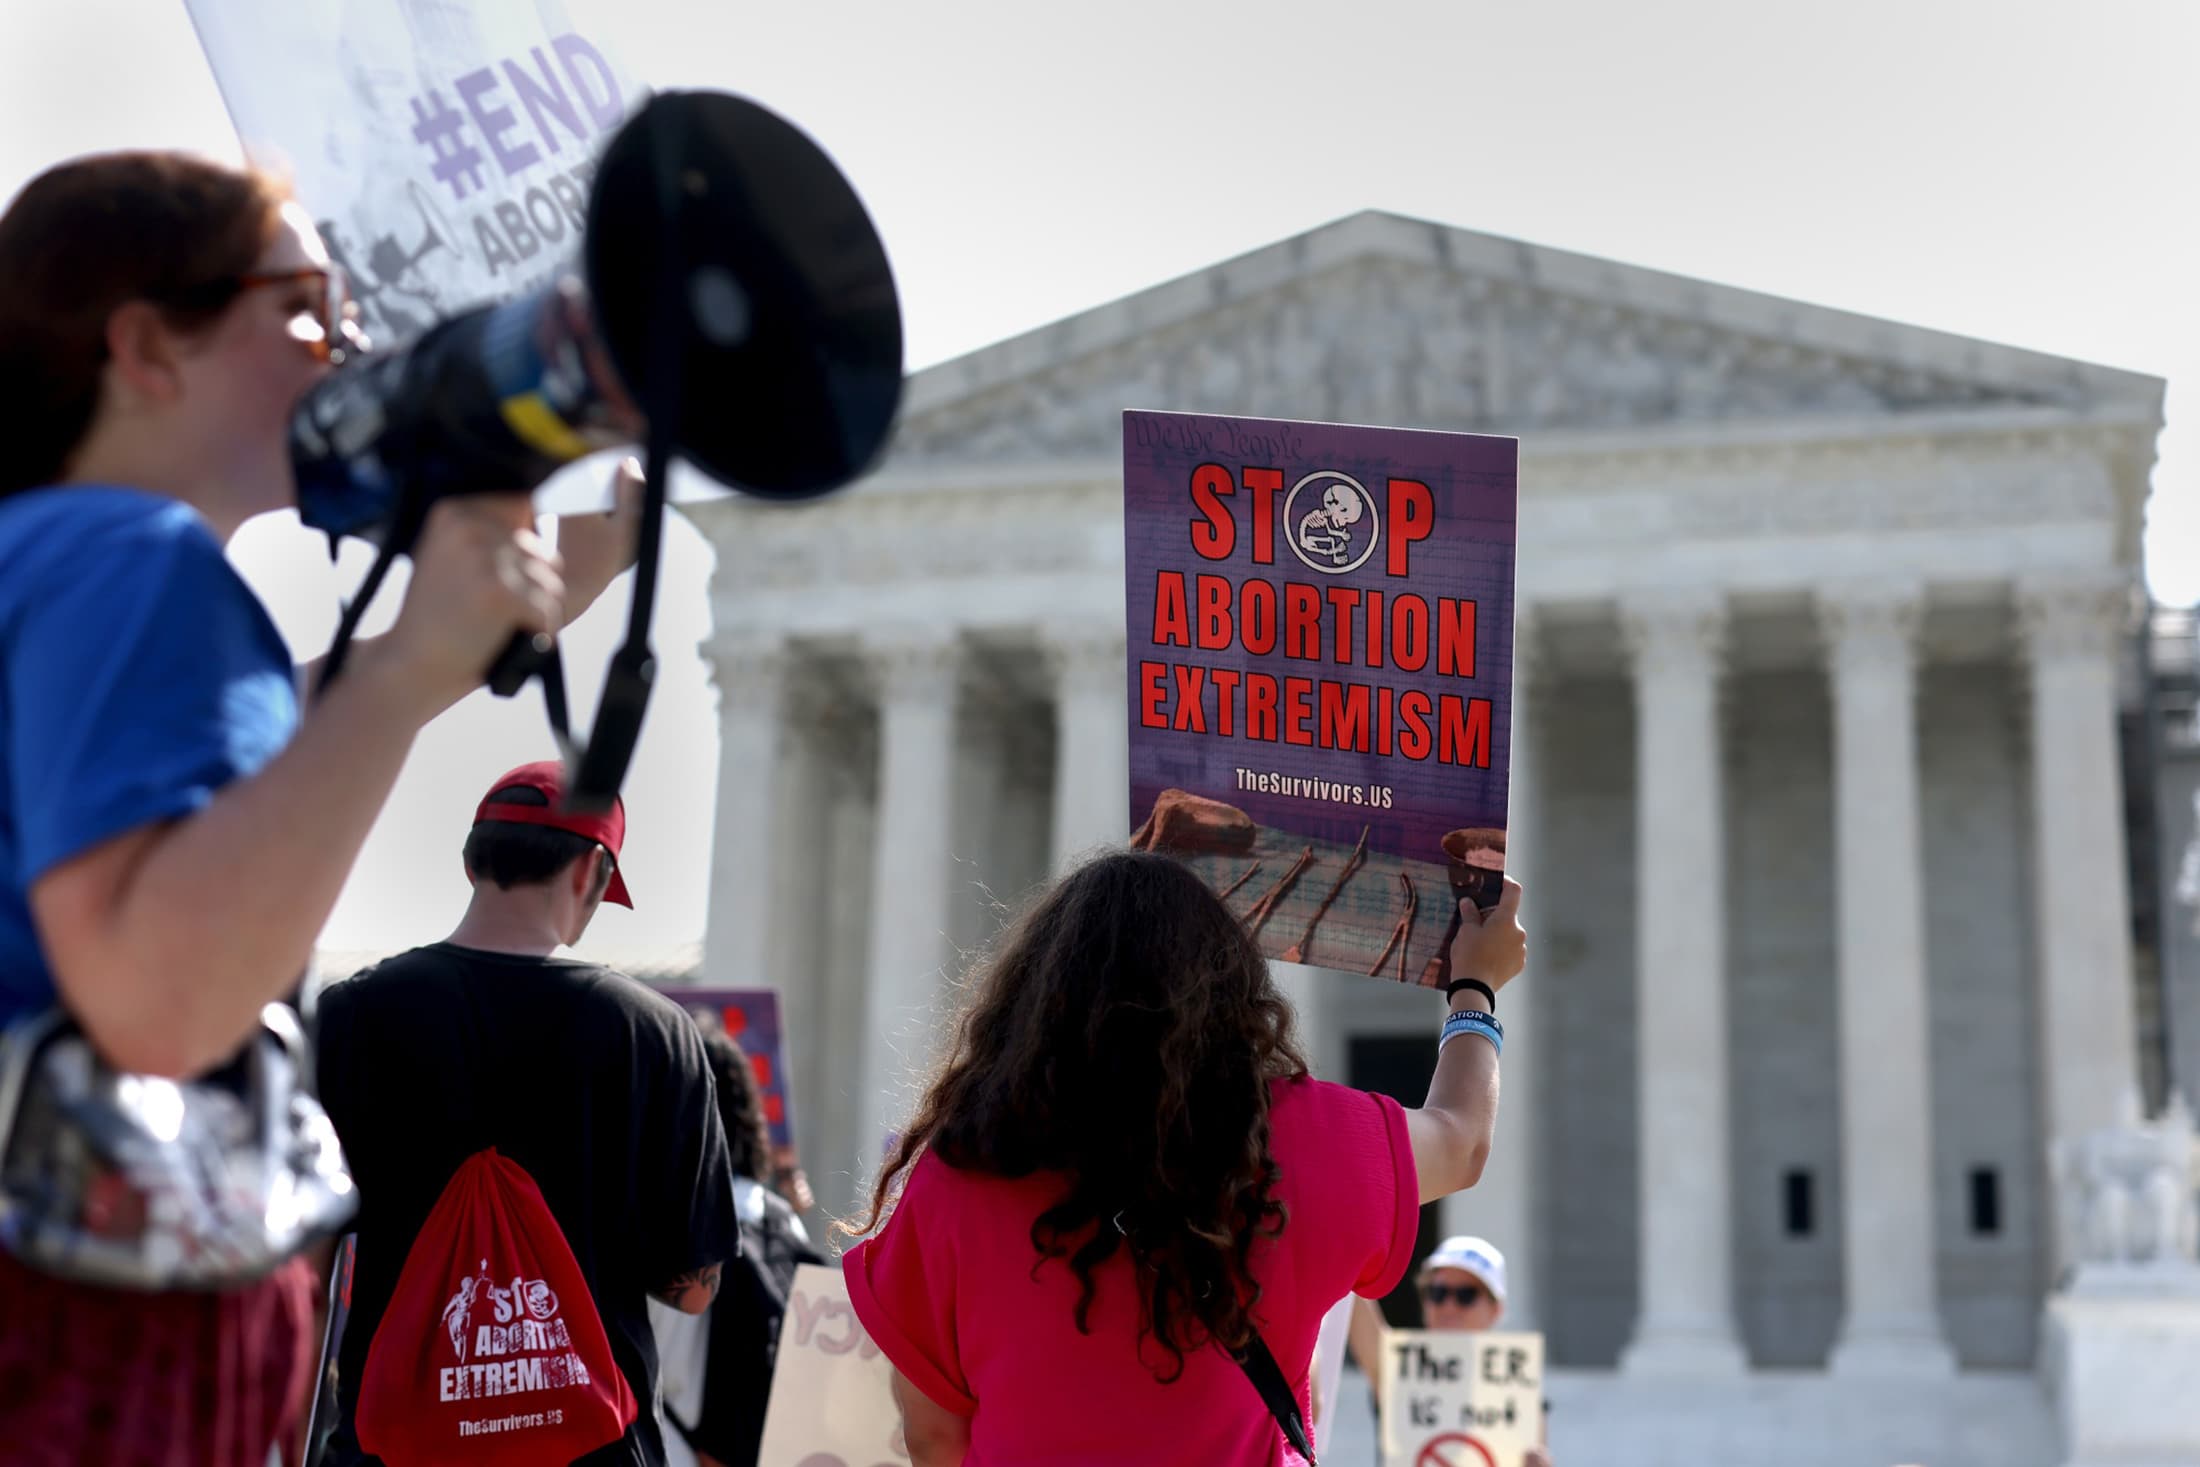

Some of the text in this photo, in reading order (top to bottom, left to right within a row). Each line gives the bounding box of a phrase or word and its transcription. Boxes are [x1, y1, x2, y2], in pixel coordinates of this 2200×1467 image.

[410, 33, 627, 200] #END
[1190, 462, 1436, 578] STOP
[1152, 569, 1478, 679] ABORTION
[1139, 660, 1493, 769] EXTREMISM
[1235, 767, 1393, 809] TheSurvivors.US
[1395, 1344, 1462, 1382] The
